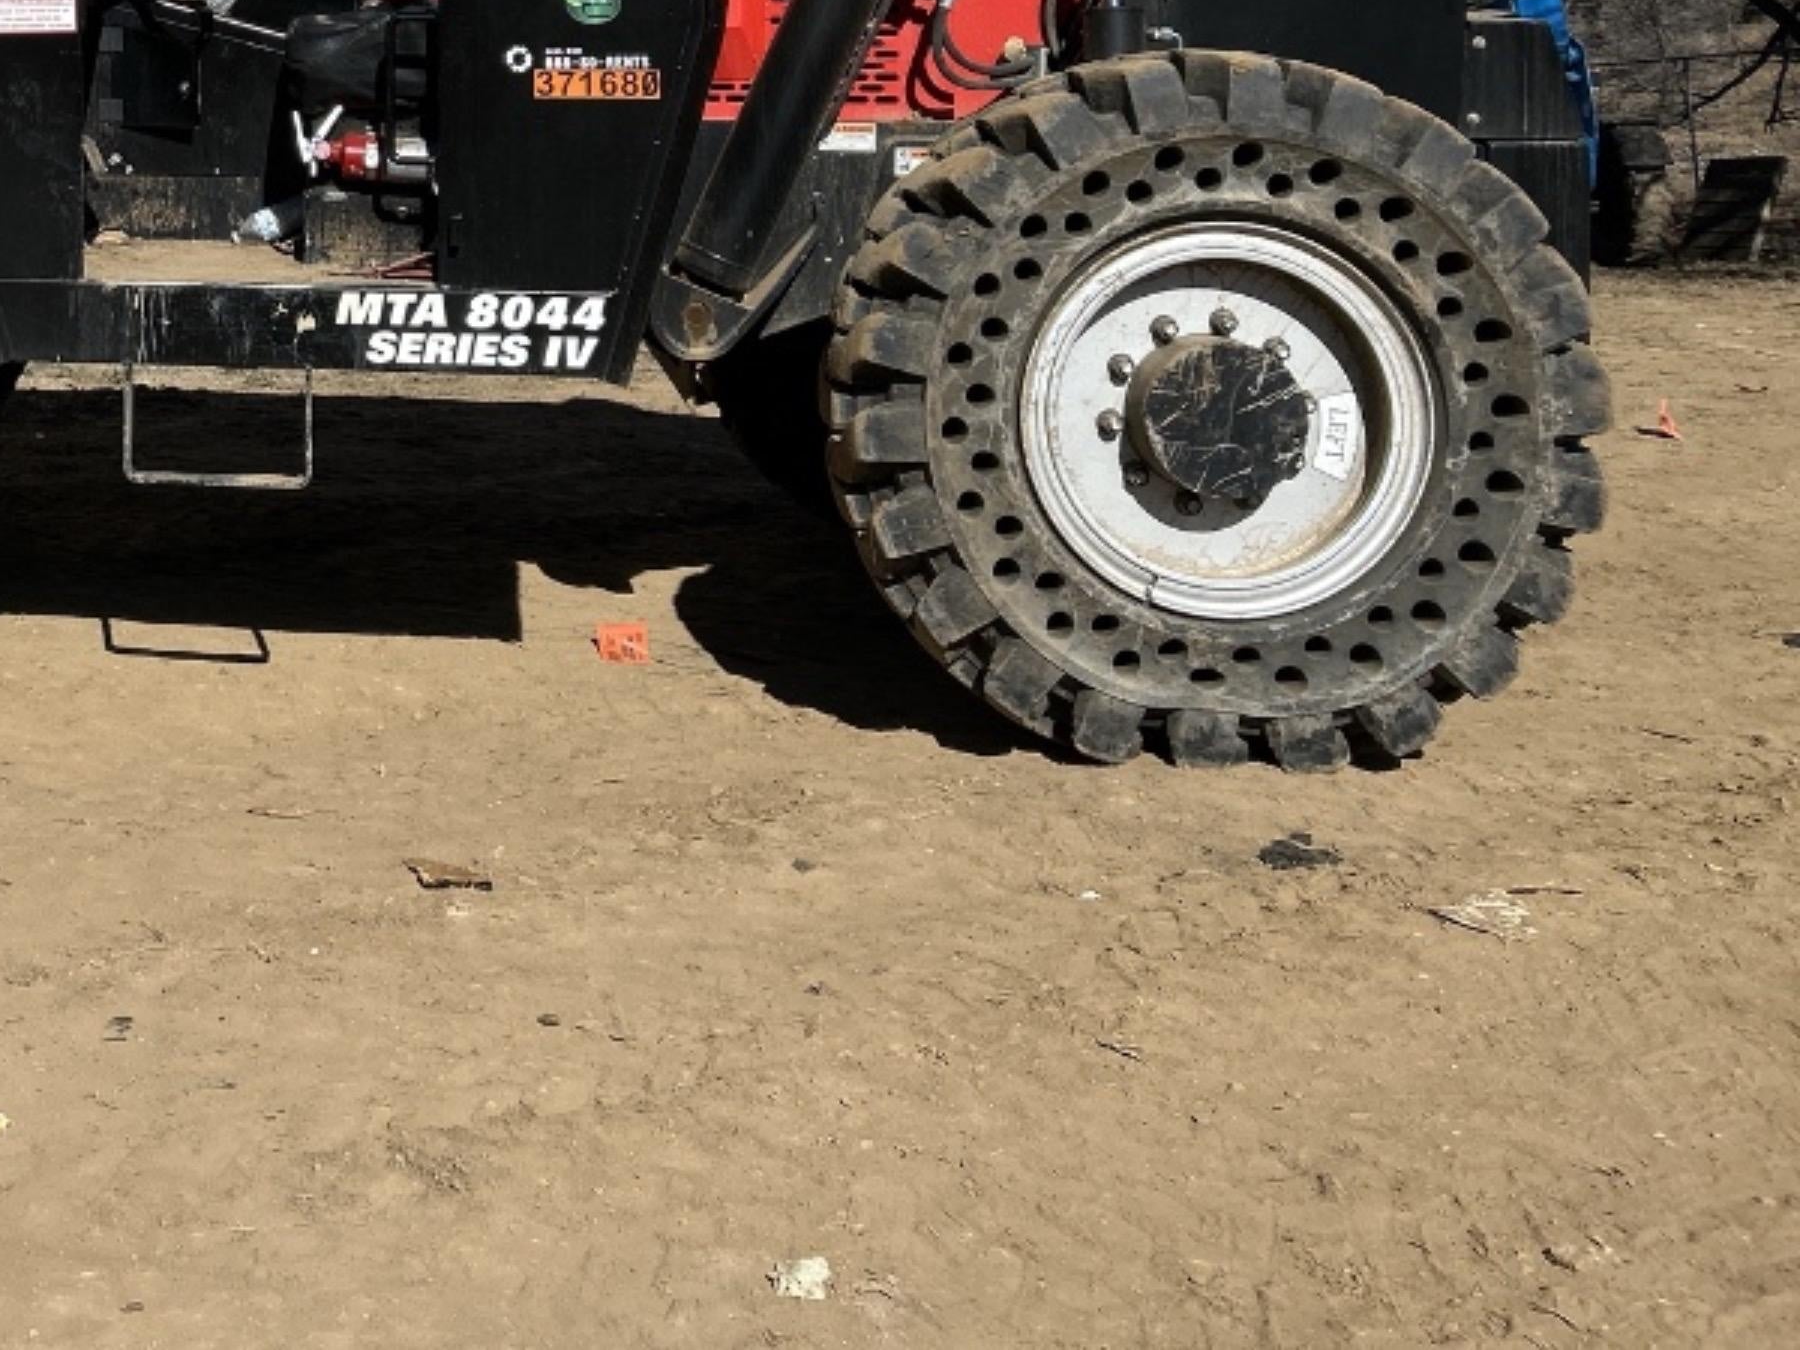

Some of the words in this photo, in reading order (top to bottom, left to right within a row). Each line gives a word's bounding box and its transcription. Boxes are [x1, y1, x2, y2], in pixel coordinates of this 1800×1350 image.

[536, 71, 657, 96] 371680
[335, 291, 448, 327] MTA
[465, 293, 607, 331] 8044
[365, 330, 531, 367] SERIES
[542, 336, 599, 369] IV
[1325, 407, 1350, 463] LEFT
